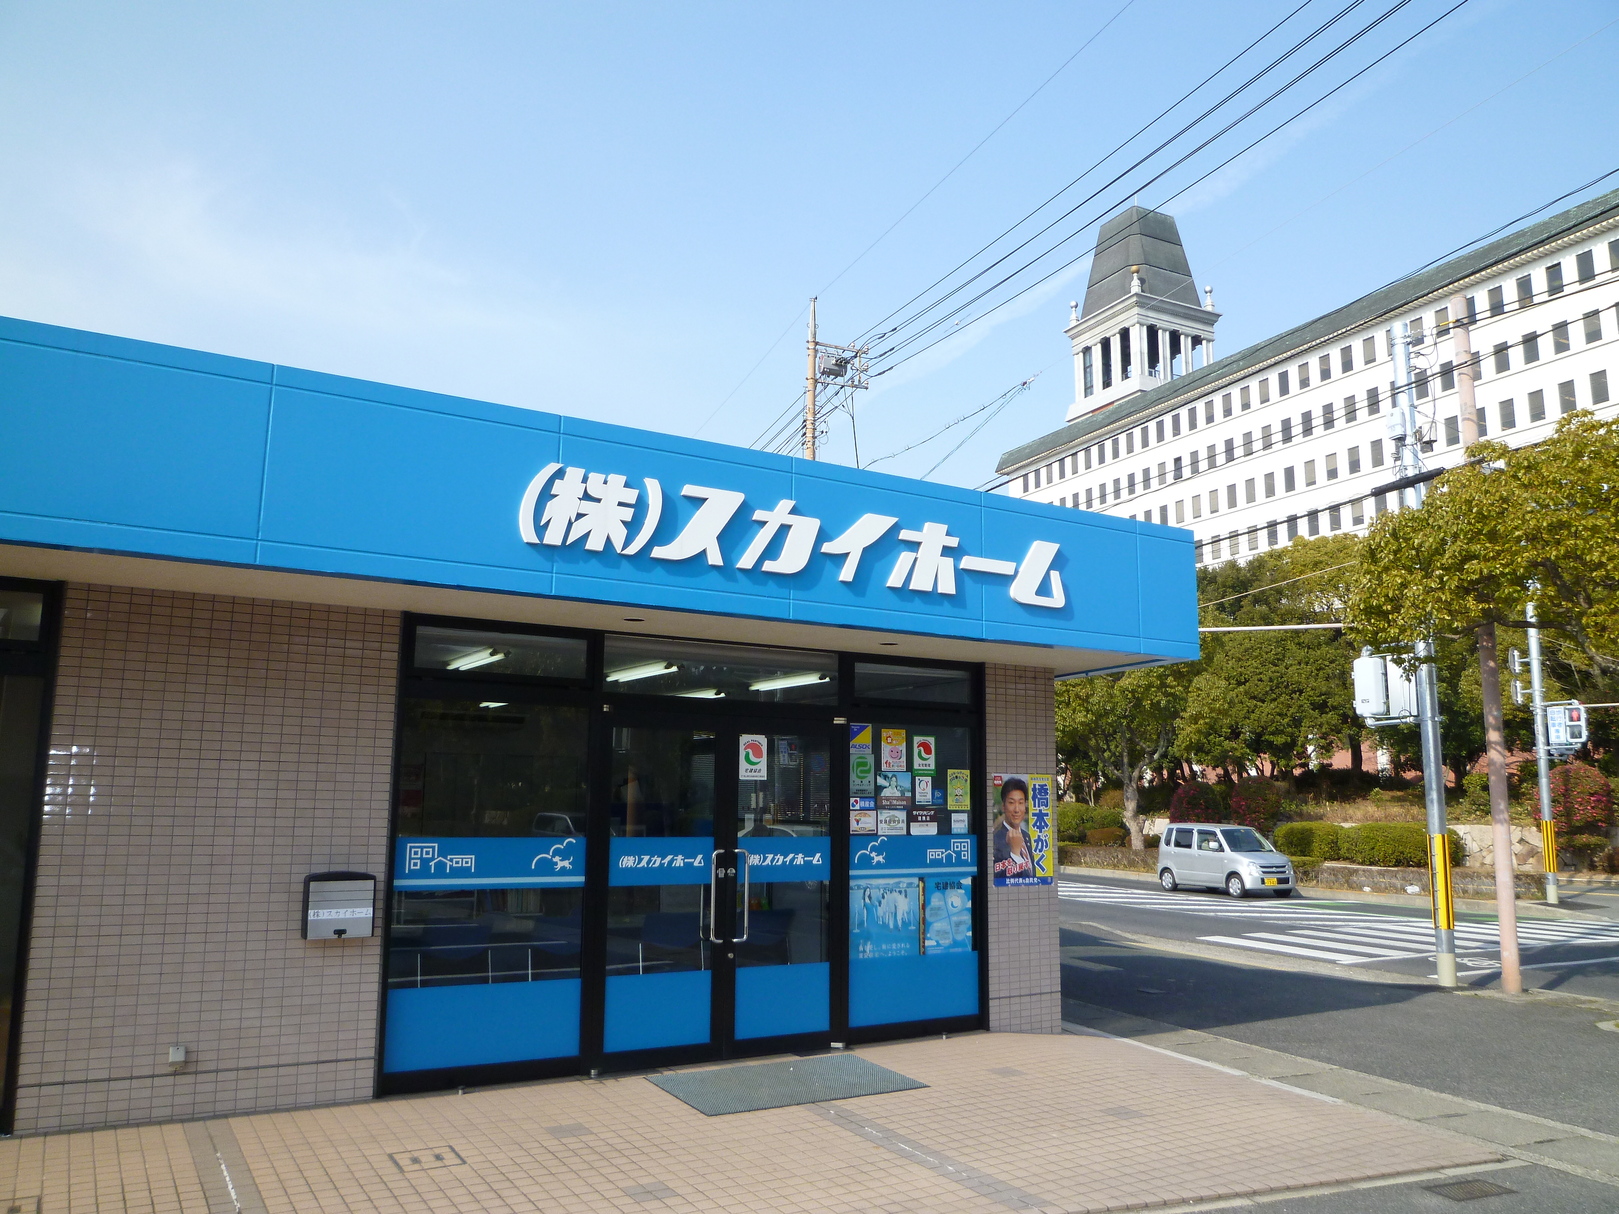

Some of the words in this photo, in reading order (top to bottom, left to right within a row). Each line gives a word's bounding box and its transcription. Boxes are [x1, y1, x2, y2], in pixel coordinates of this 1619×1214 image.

[518, 462, 1067, 609] (株)スカイホーム
[619, 854, 705, 868] (株)スカイホーム
[1030, 783, 1050, 874] 橋本がく
